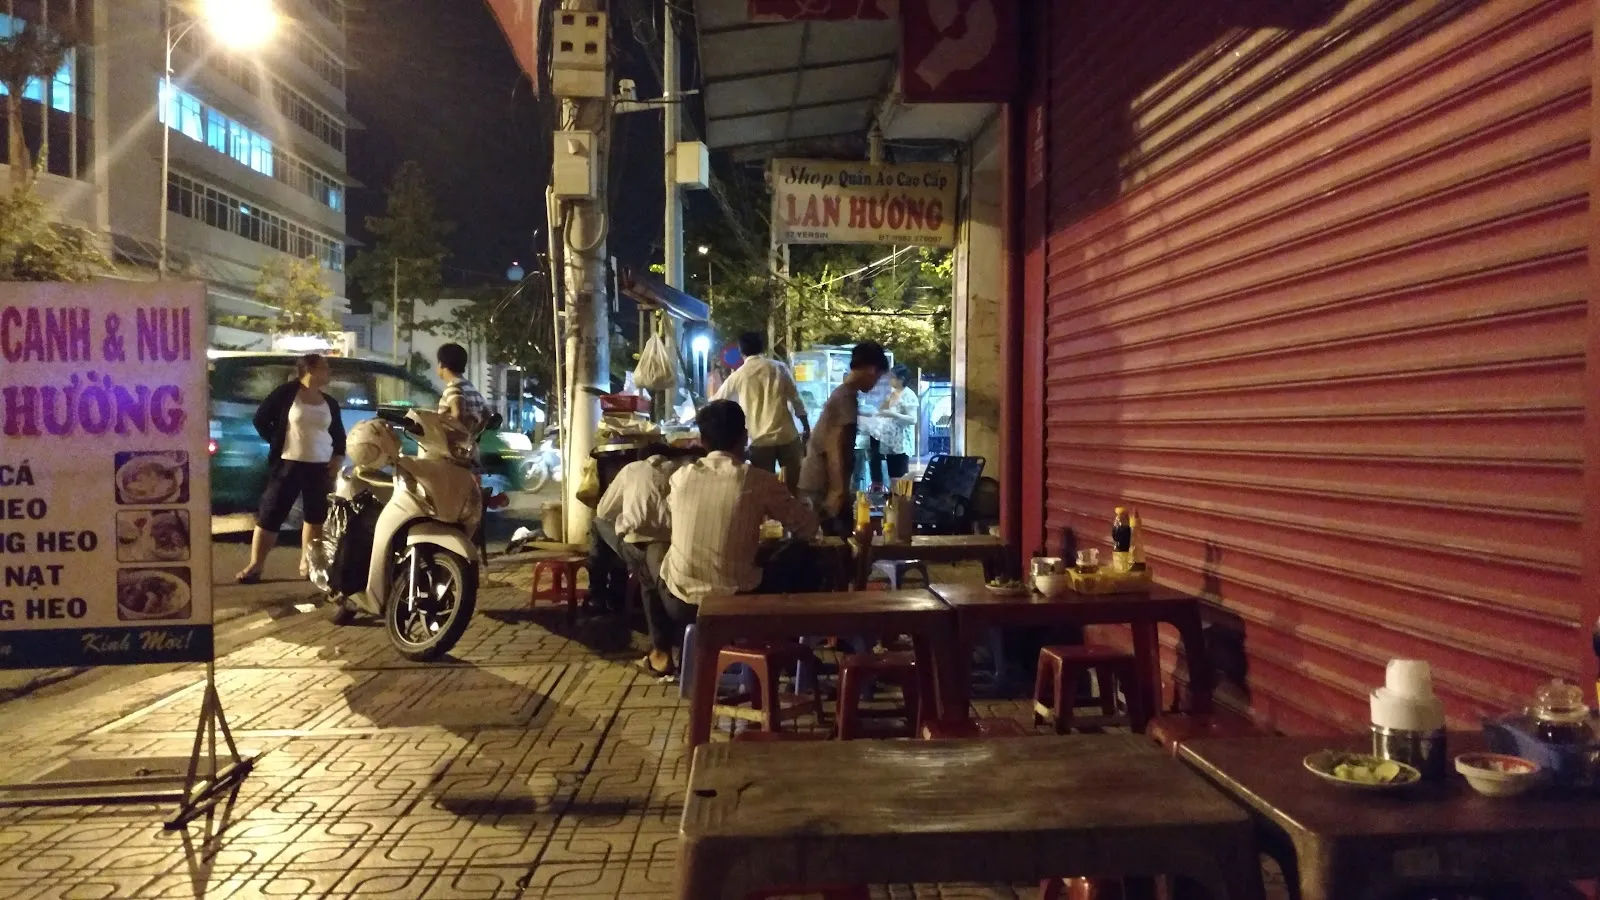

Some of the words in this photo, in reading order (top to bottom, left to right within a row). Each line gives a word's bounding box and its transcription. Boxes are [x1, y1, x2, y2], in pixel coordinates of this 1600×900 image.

[785, 165, 834, 190] Shop
[786, 193, 841, 228] LAN
[848, 190, 944, 231] HƯƠNG
[797, 231, 829, 240] YERSIN
[1, 306, 91, 362] CANH
[103, 312, 125, 362] &
[136, 306, 191, 364] NUI
[3, 370, 187, 436] HƯỜNG
[0, 459, 35, 486] CÁ
[0, 498, 47, 520] EO
[37, 530, 98, 552] HEO
[5, 564, 64, 591] NẠT
[26, 597, 87, 620] HEO
